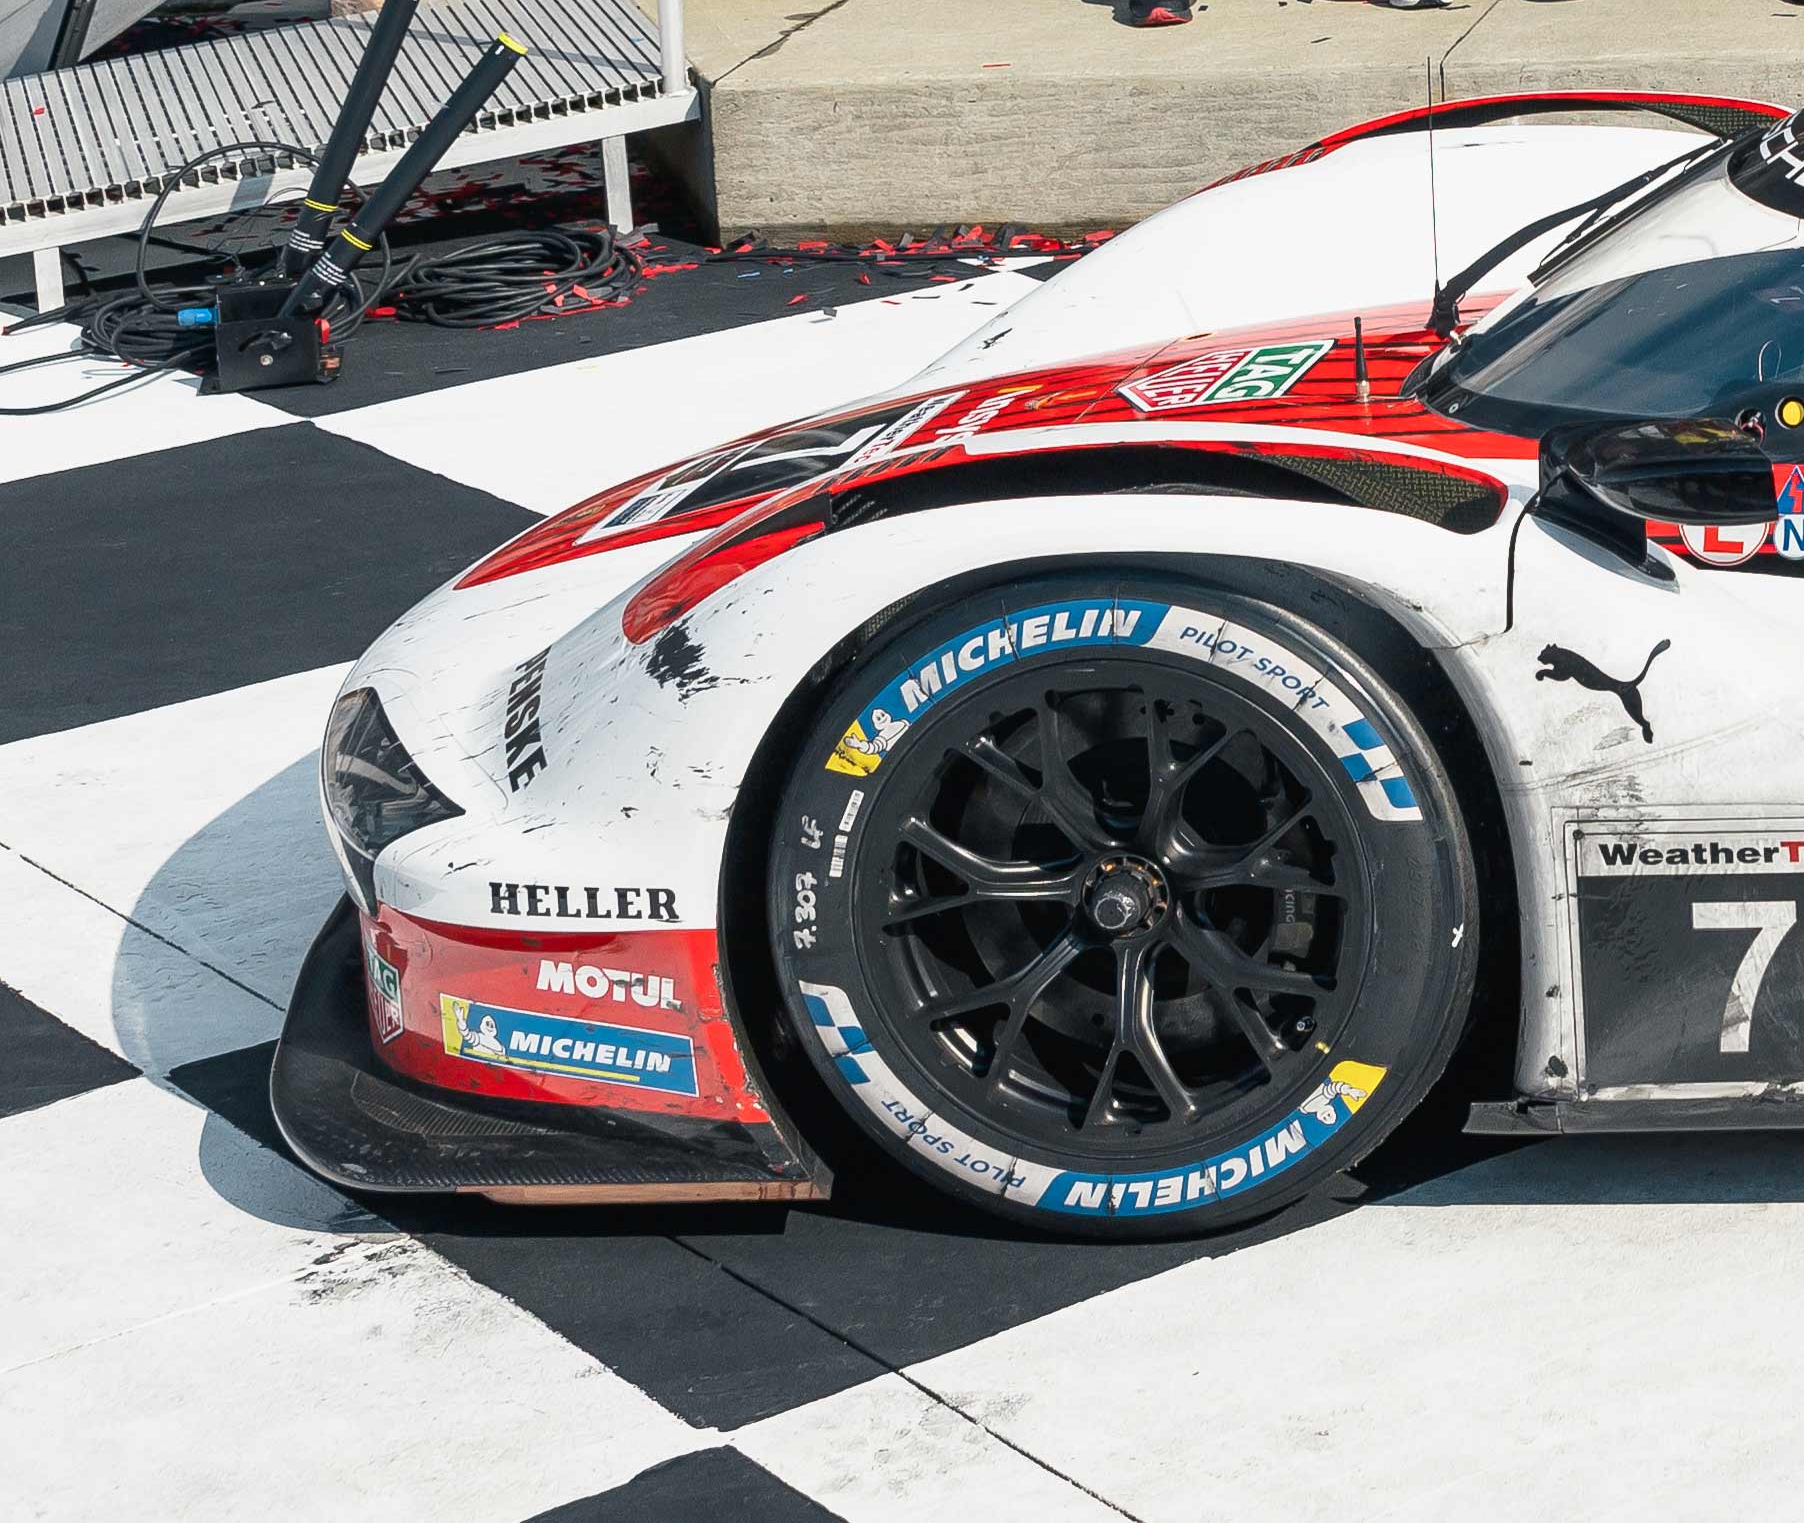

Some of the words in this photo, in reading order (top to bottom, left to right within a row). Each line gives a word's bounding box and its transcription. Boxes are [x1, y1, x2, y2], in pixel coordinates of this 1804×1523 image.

[900, 608, 1143, 715] MICHELIN
[1179, 624, 1251, 667] PILOT
[1250, 654, 1330, 711] SPORT
[489, 881, 681, 922] HELLER
[536, 960, 682, 1011] MOTUL
[1690, 900, 1797, 1054] 7
[508, 1030, 671, 1074] MICHELIN
[1063, 1120, 1308, 1210] MICHELIN
